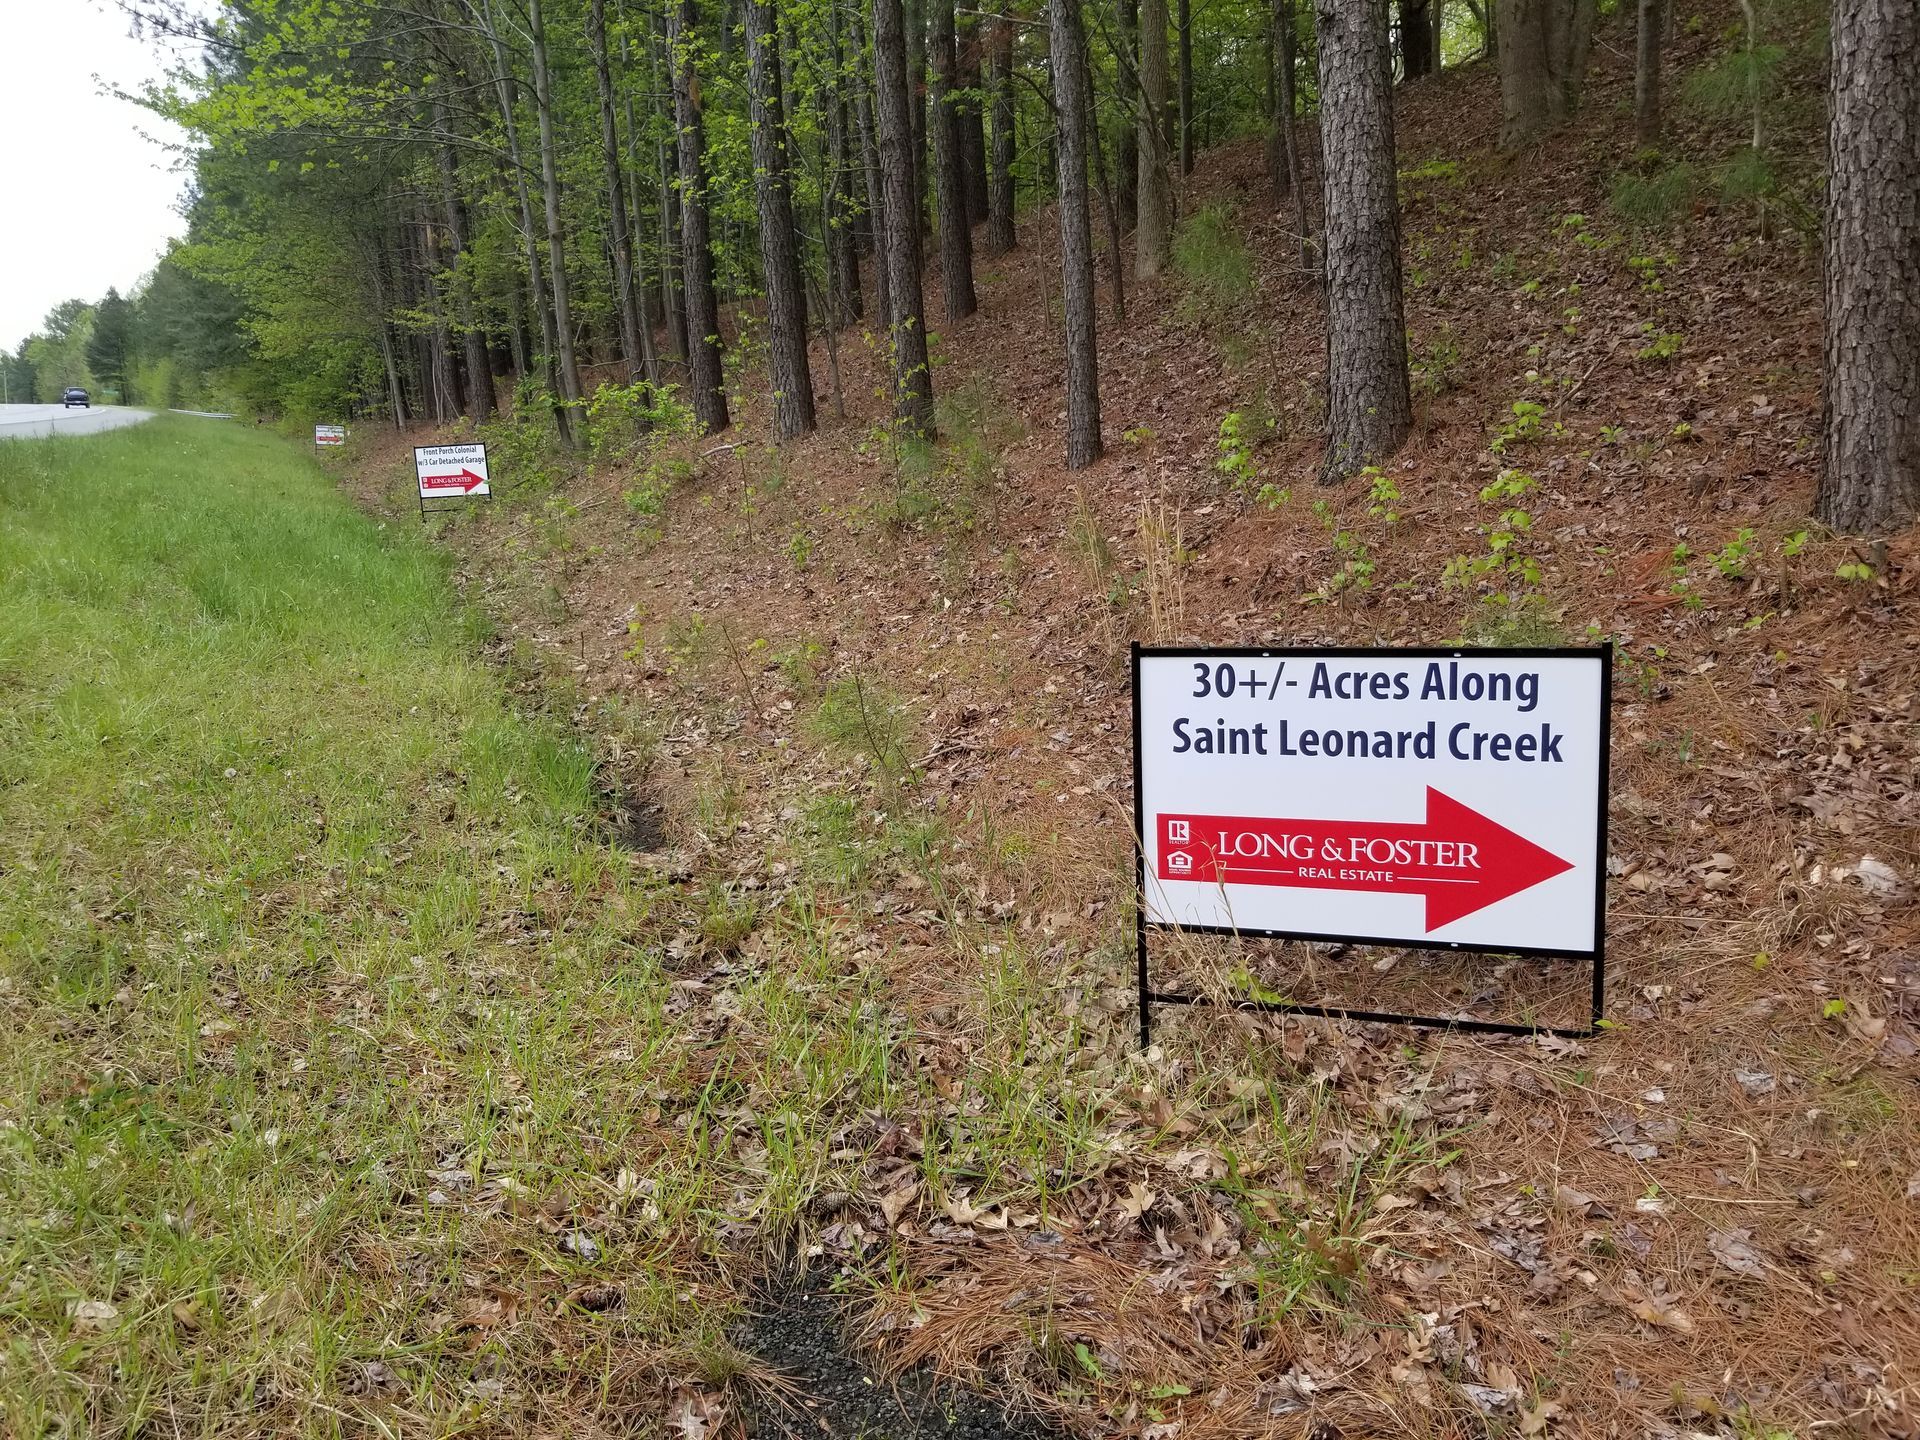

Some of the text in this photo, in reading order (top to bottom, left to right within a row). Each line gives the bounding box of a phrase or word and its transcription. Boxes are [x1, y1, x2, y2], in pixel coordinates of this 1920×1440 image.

[423, 446, 477, 456] Front Porch Colonial
[439, 457, 465, 465] Detached
[465, 456, 485, 464] Garage
[1192, 661, 1540, 713] 30+/- Acres Along
[1172, 718, 1564, 763] Saint Leonard Creek
[1217, 831, 1315, 861] LONG
[1298, 866, 1395, 882] REAL ESTATE
